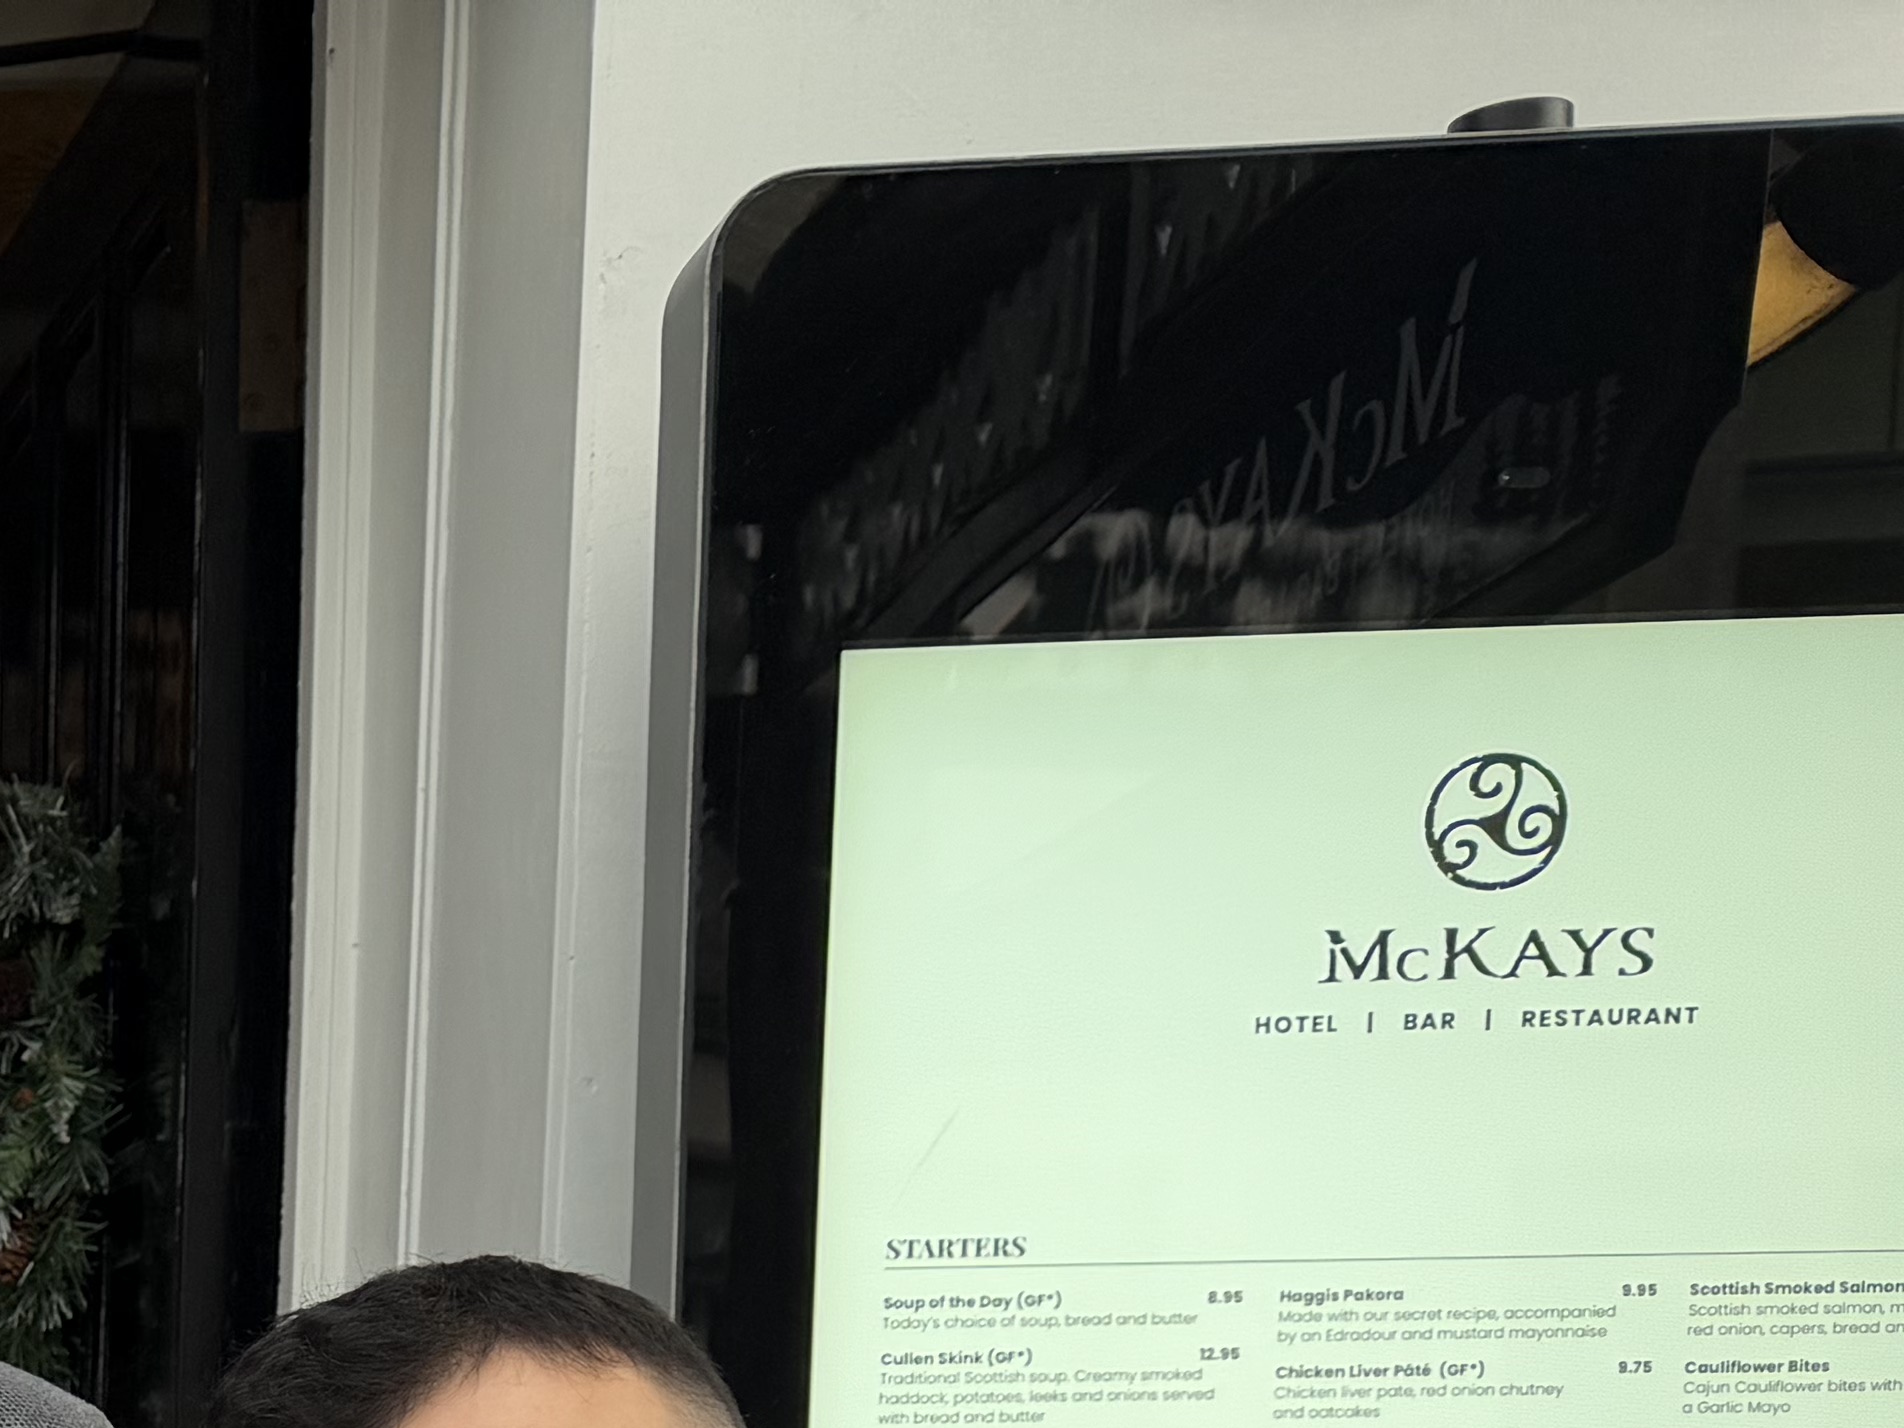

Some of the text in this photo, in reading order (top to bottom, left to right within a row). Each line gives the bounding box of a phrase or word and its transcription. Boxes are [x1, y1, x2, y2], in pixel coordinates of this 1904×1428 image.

[1318, 926, 1654, 983] McKAYS
[1255, 1007, 1698, 1034] HOTEL BAR RESTAURANT
[886, 1237, 1026, 1259] STARTERS
[1280, 1288, 1404, 1306] Haggis Pakora
[1690, 1280, 1904, 1296] Scottish Smoked Salmon
[1685, 1359, 1829, 1374] Cauliflower Bites
